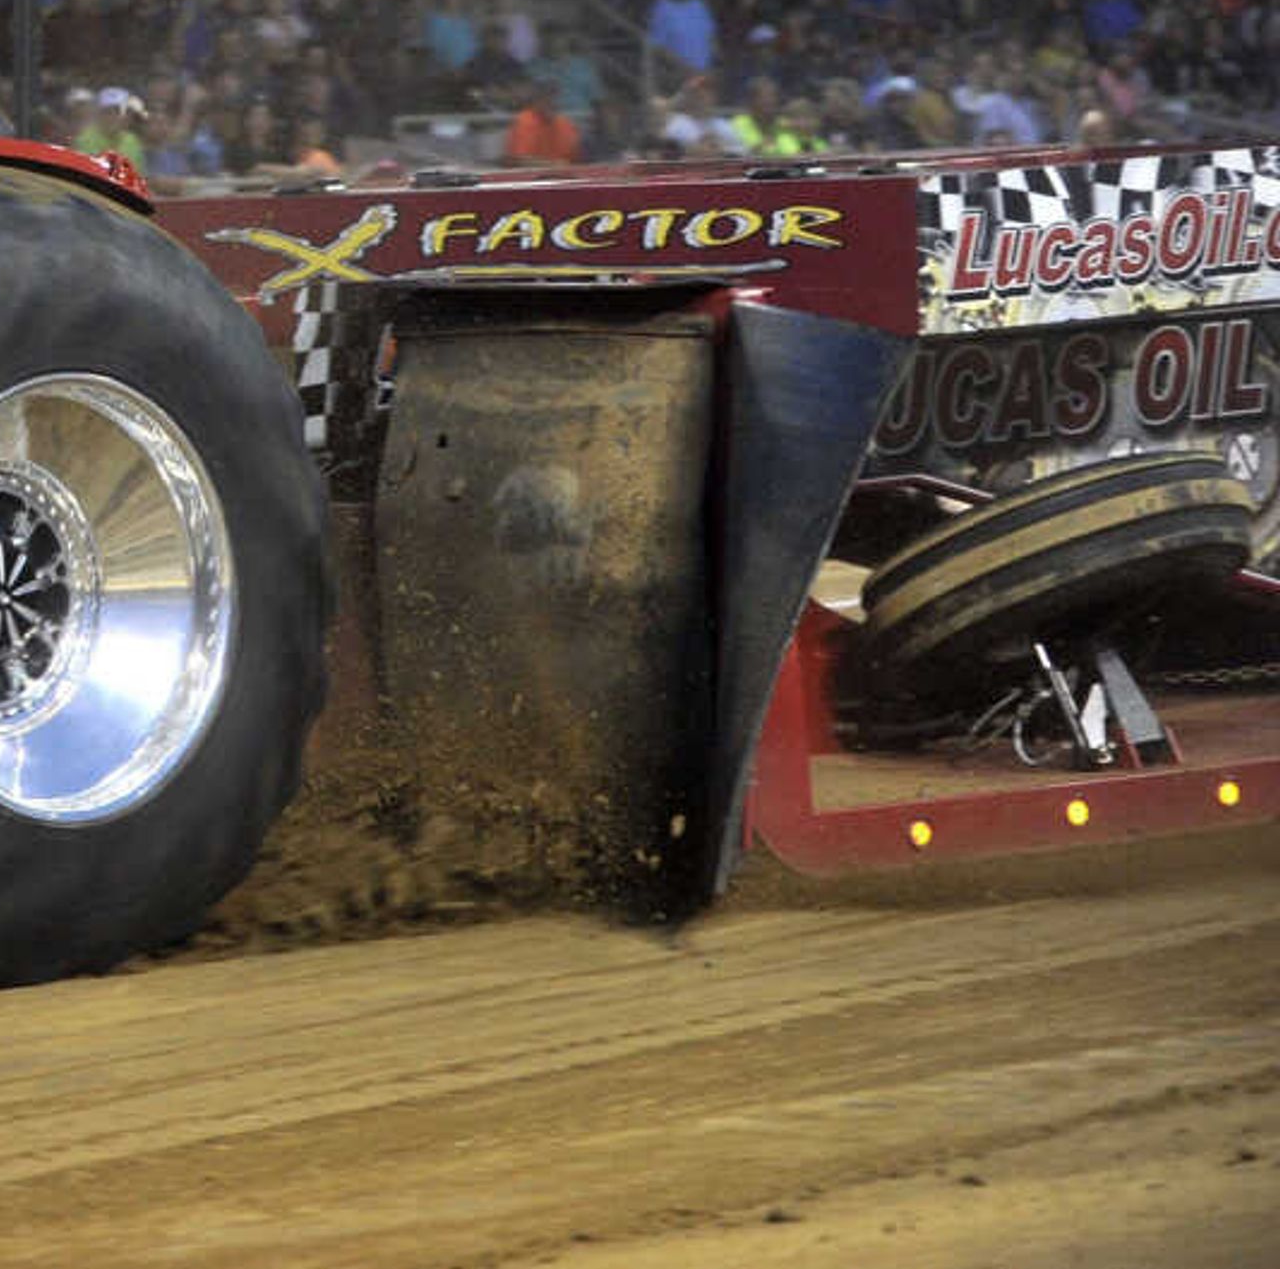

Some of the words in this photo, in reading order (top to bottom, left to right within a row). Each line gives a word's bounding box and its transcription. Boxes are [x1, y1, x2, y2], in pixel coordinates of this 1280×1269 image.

[420, 206, 845, 257] FACTOR
[872, 333, 1110, 456] UCAS
[1134, 317, 1270, 427] OIL
